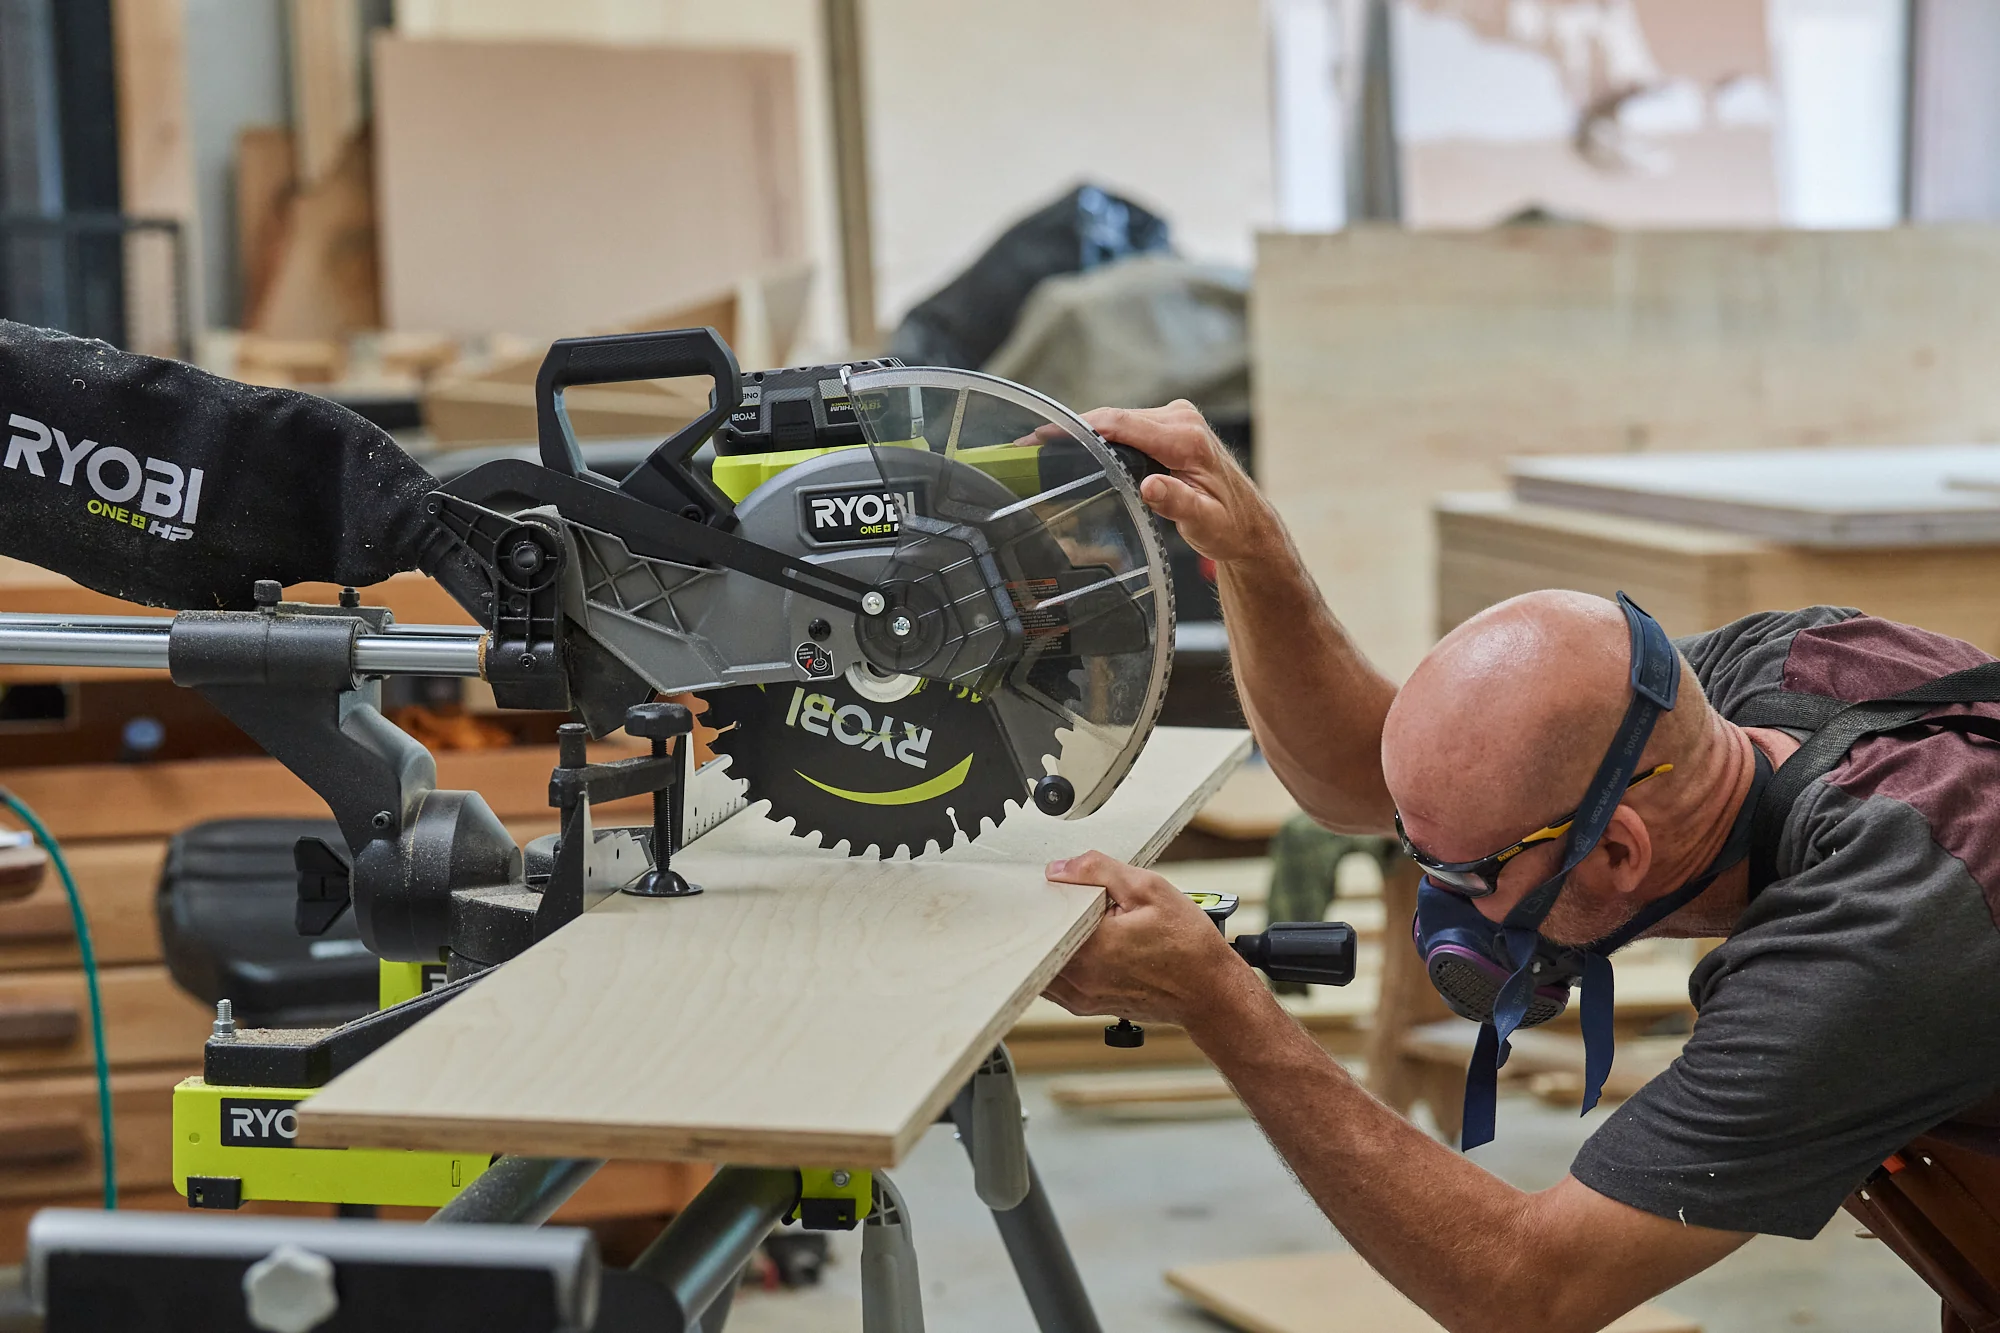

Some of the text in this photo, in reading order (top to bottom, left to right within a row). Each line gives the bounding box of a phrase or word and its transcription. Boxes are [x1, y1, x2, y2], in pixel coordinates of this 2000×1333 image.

[731, 411, 757, 421] RYOBI
[3, 413, 204, 524] RYOBI
[811, 491, 917, 529] RYOBI
[148, 520, 194, 541] HP
[785, 686, 933, 769] RYOBI
